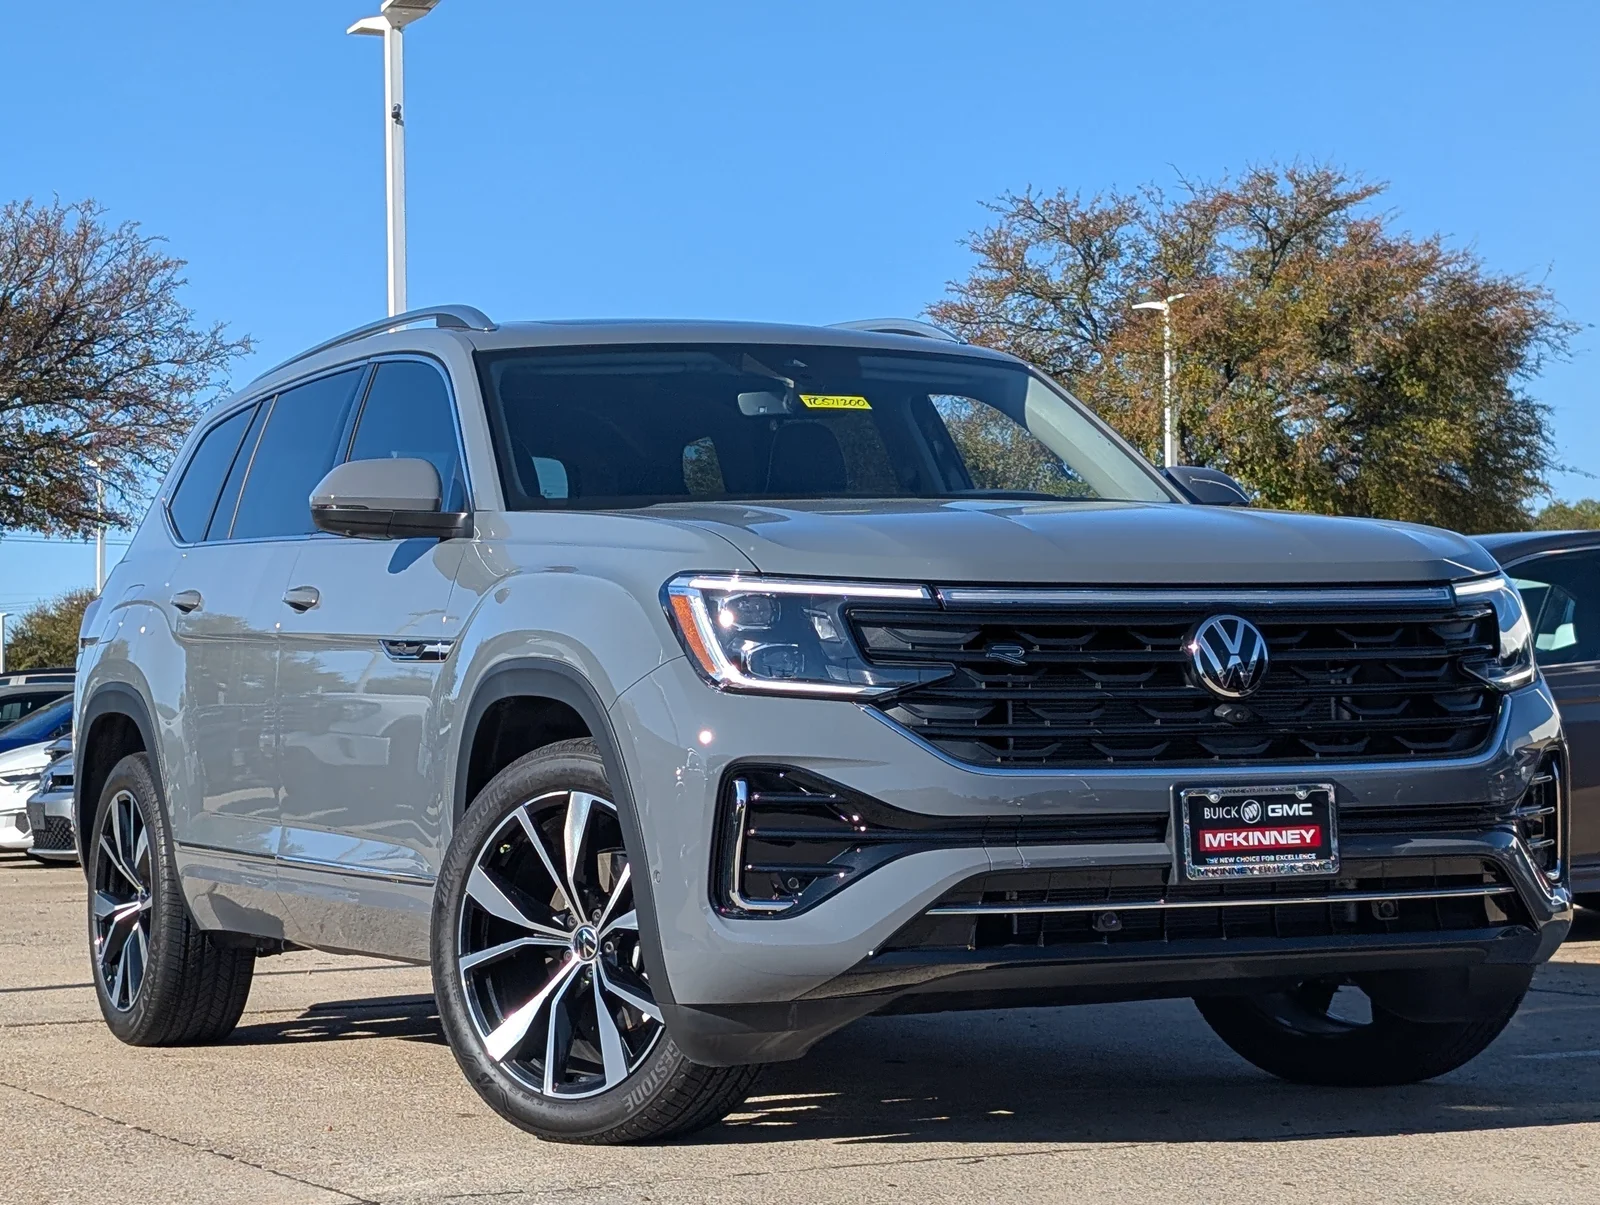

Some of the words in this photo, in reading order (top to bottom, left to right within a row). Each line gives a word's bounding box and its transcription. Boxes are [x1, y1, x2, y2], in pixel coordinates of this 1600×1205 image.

[1204, 806, 1239, 819] BUICK
[1268, 803, 1313, 817] GMC
[1204, 829, 1316, 848] McKINNEY
[1219, 856, 1235, 864] NEW
[1235, 855, 1260, 863] CHOICE
[1261, 854, 1275, 862] FOR
[1276, 853, 1316, 861] EXCELLENCE
